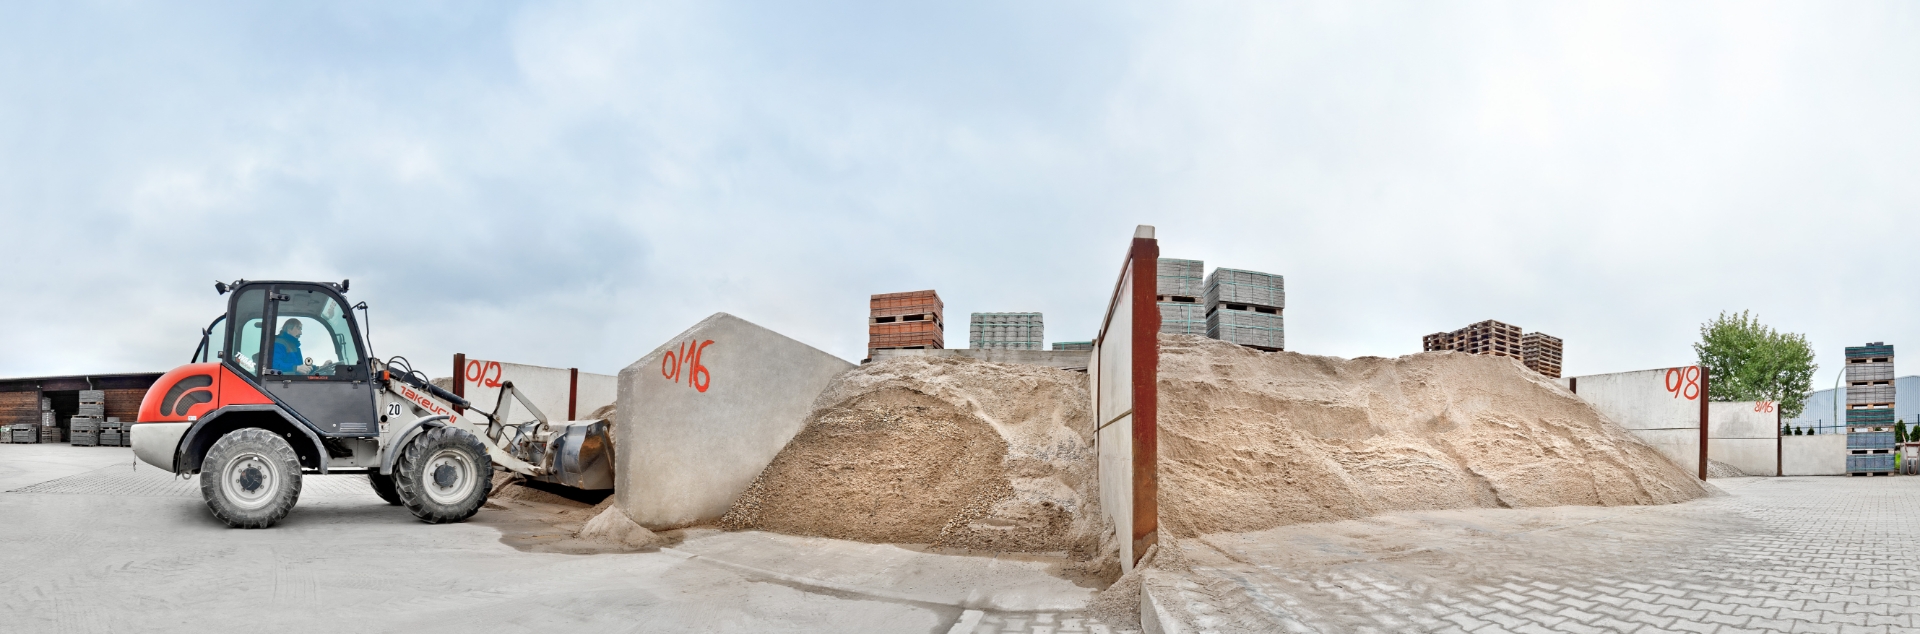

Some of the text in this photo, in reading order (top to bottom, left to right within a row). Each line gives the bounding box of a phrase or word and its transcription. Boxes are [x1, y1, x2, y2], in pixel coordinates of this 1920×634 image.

[466, 360, 503, 388] 0/2
[661, 339, 714, 392] 0/16
[1665, 366, 1700, 400] 0/8
[389, 404, 400, 415] 20
